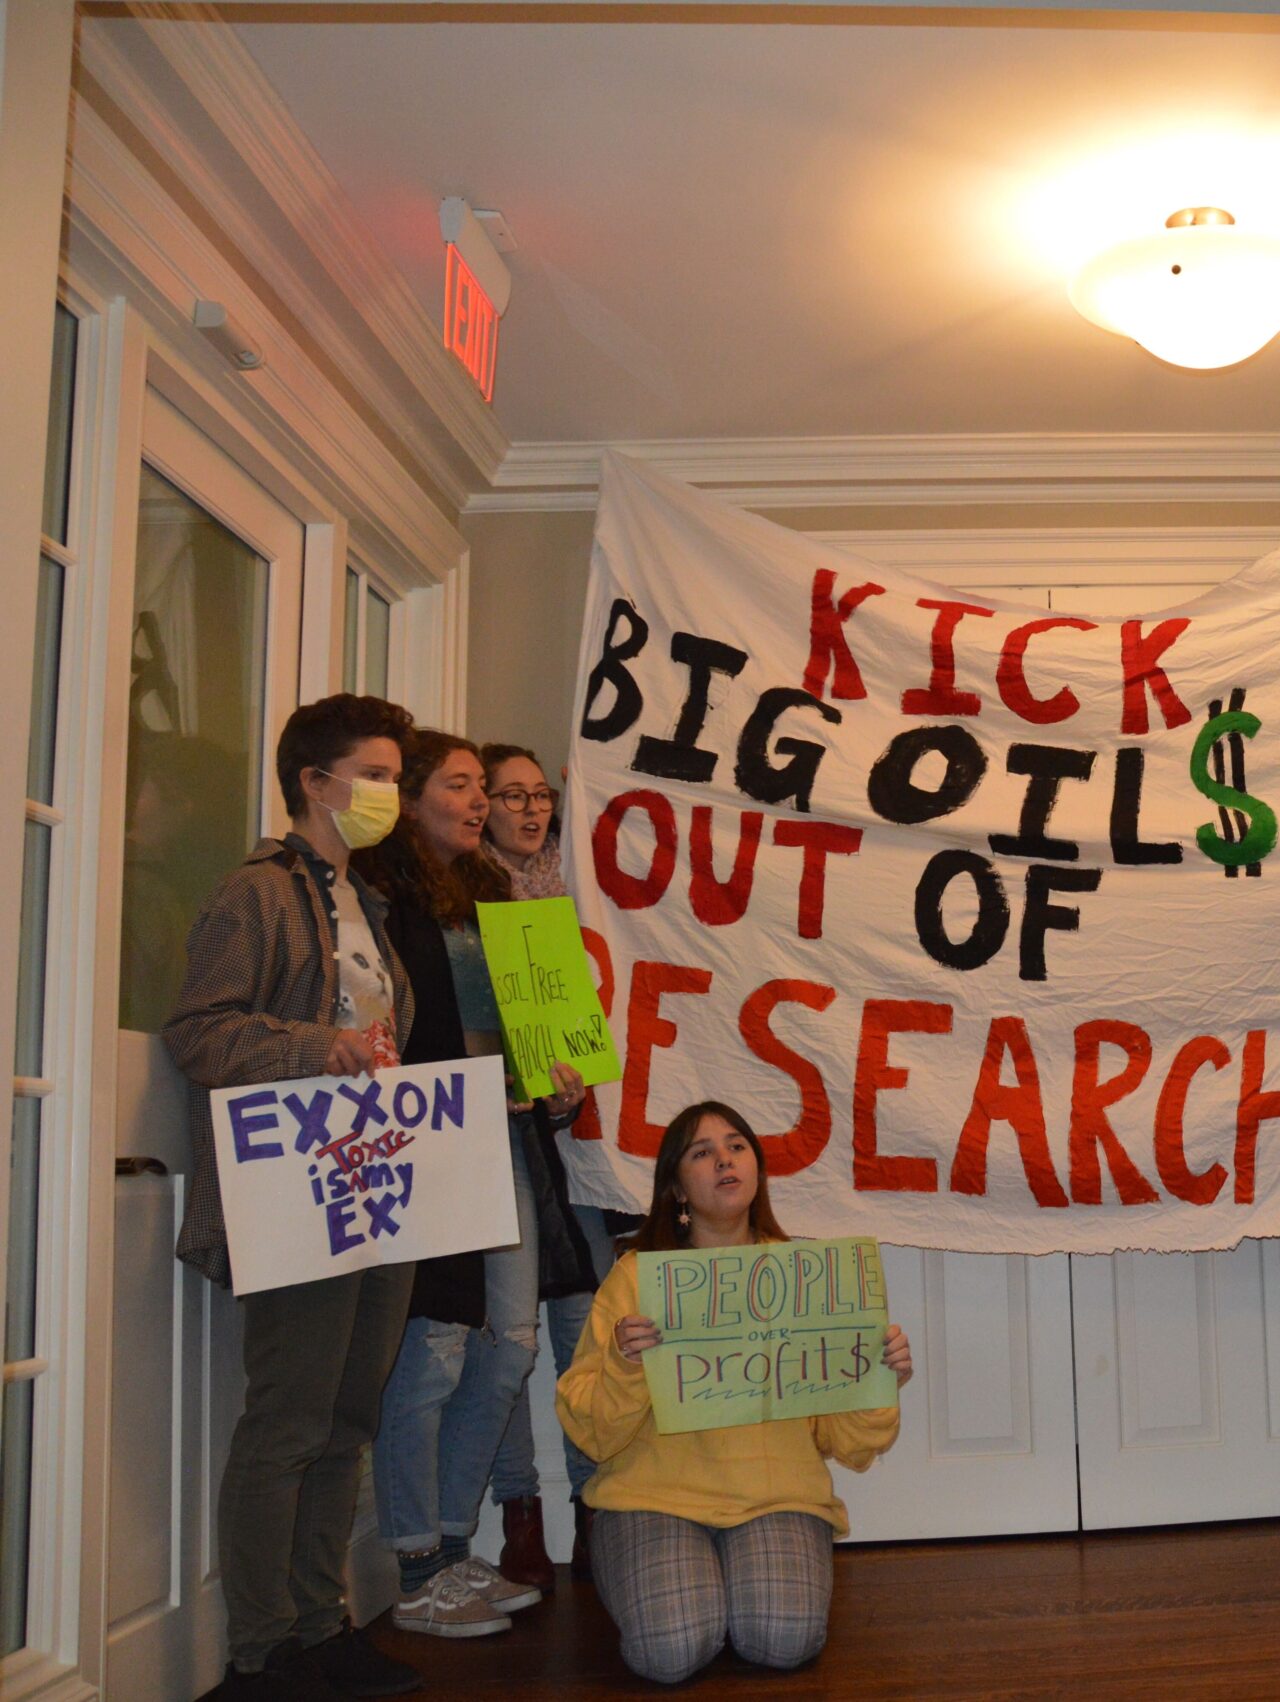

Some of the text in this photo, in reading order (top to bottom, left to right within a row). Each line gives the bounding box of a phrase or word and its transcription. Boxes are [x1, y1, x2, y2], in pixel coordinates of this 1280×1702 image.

[453, 262, 494, 391] EXIT
[802, 569, 1192, 735] KICK
[580, 599, 1278, 878] BIG OIL$
[592, 788, 1103, 981] OUT OF
[522, 925, 569, 1007] FREE
[562, 1014, 607, 1058] NOW!
[227, 1073, 464, 1163] EXXON
[308, 1162, 414, 1209] is my
[663, 1243, 886, 1330] PEOPLE
[677, 1332, 871, 1403] profit$
[748, 1328, 790, 1342] OVER
